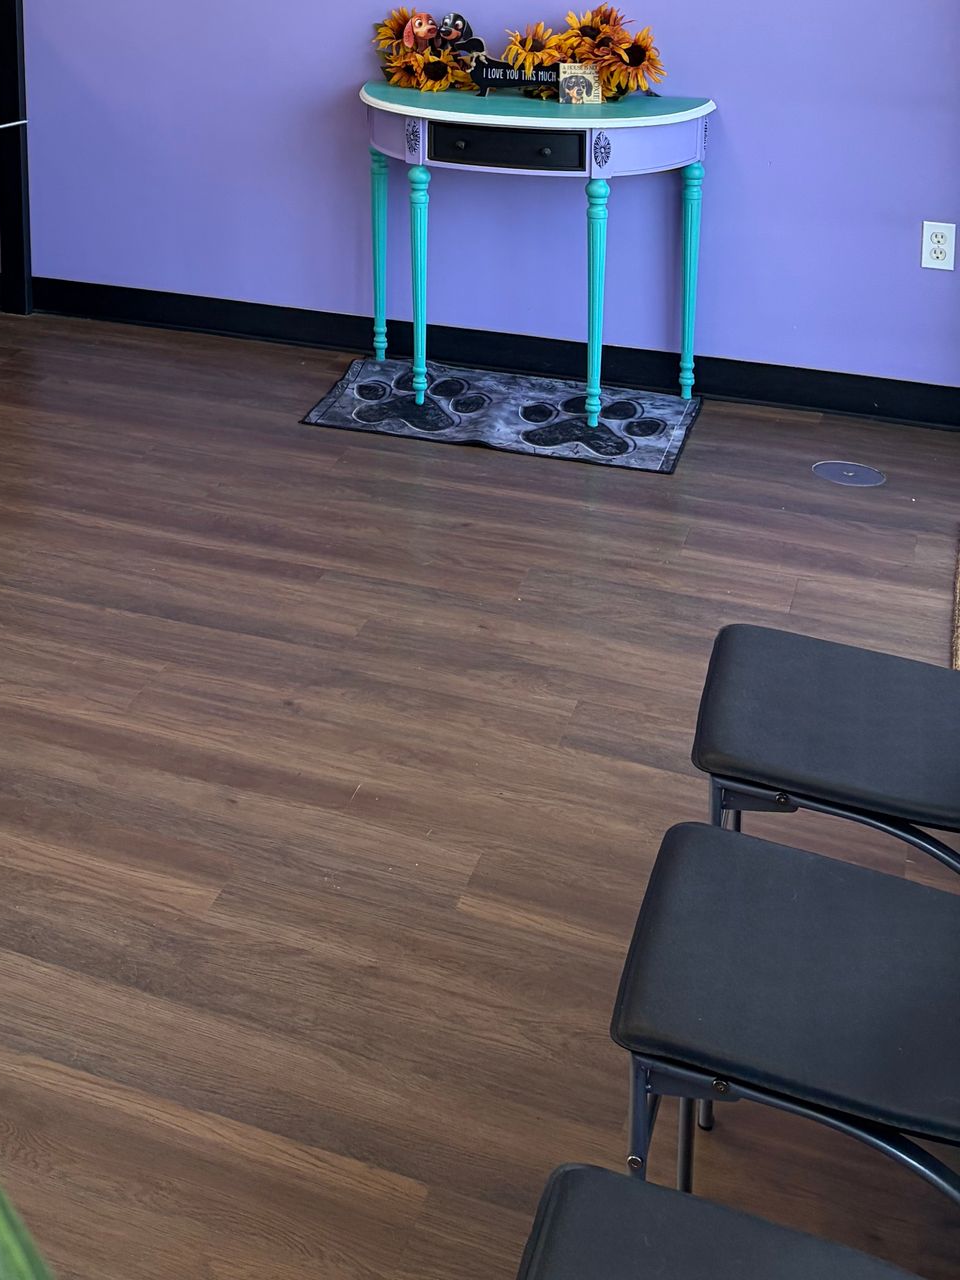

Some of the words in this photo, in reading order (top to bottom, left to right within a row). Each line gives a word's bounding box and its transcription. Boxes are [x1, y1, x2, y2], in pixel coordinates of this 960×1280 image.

[488, 68, 504, 79] LOVE
[506, 69, 519, 80] YOU
[538, 70, 556, 82] MUCH
